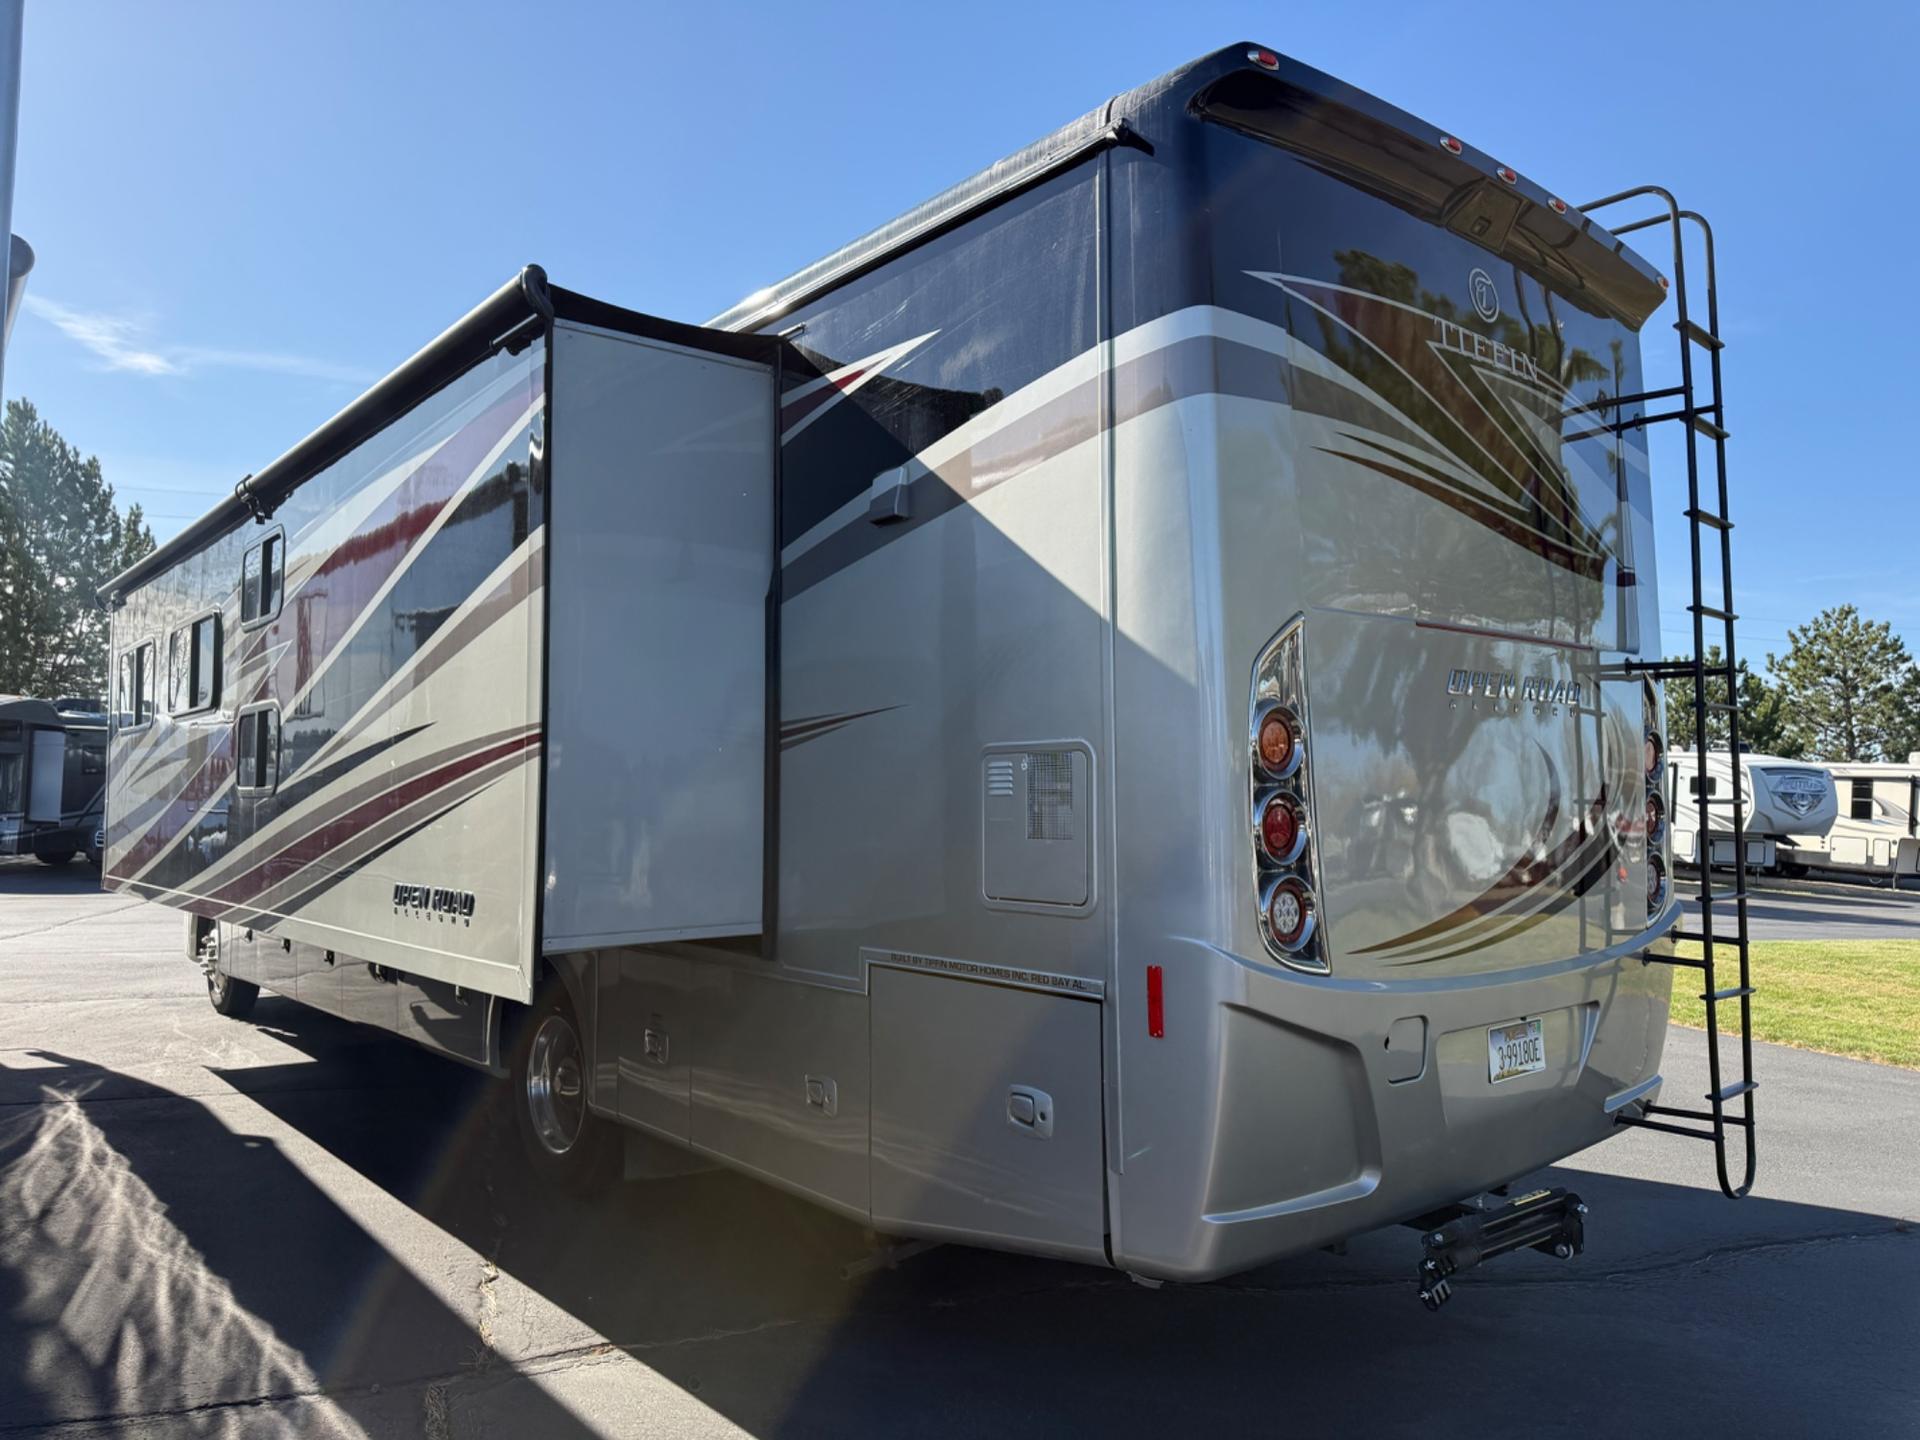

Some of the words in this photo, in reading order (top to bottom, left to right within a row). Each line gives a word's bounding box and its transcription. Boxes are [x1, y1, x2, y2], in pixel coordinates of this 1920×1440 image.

[1434, 316, 1539, 382] TIFFIN
[1447, 669, 1517, 699] OPEN
[1522, 676, 1581, 705] ROAD
[394, 882, 431, 910] OPEN
[432, 886, 475, 917] ROAD
[949, 961, 978, 974] MOTOR
[980, 965, 1011, 979] HOMES
[1031, 973, 1050, 985] RED
[1051, 976, 1070, 987] BAY
